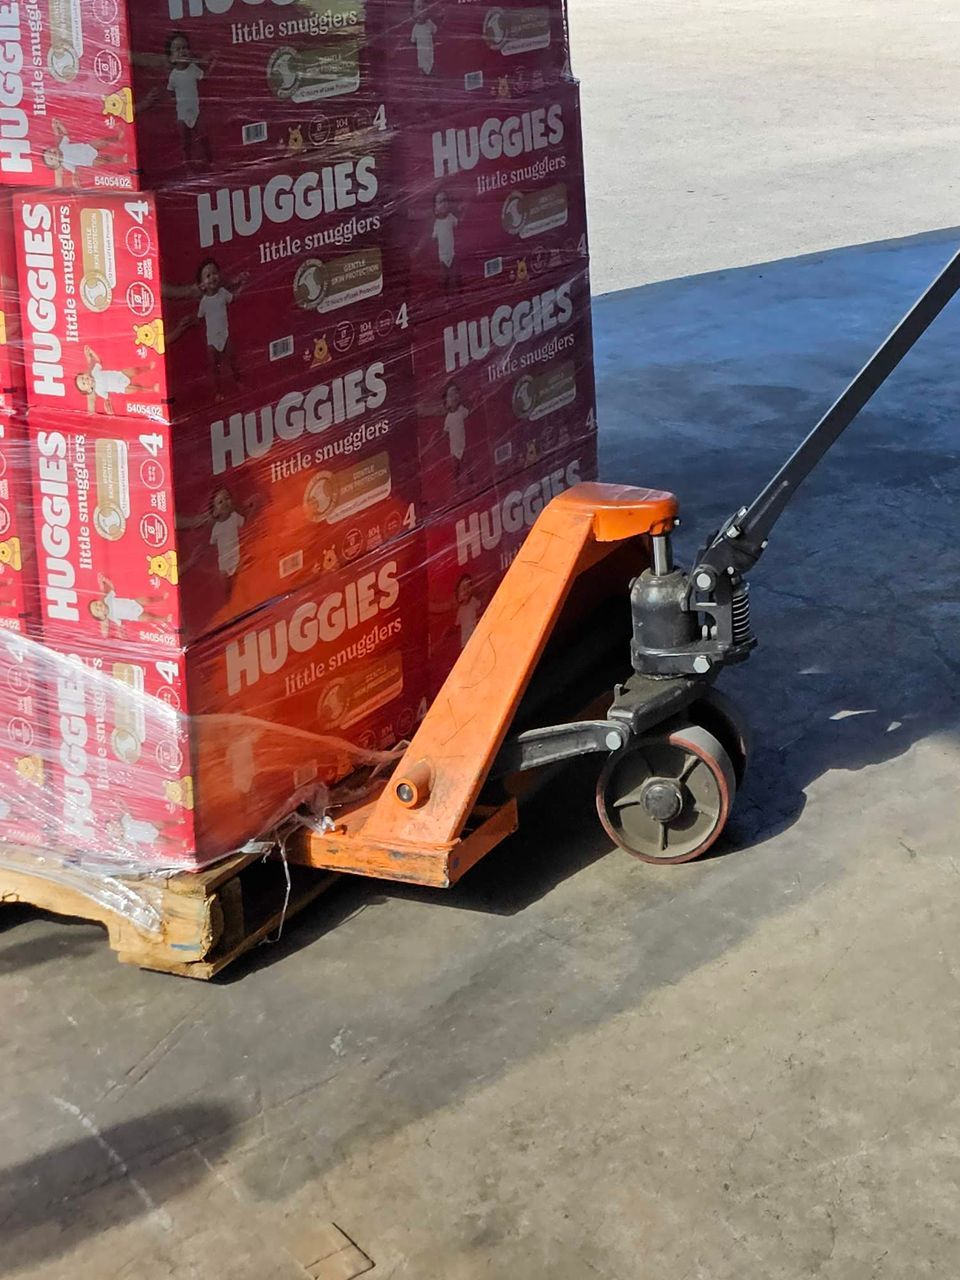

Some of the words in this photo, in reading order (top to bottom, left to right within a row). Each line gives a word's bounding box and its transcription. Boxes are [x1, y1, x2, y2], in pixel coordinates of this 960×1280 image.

[231, 19, 273, 44] little
[279, 9, 357, 36] snugglers
[32, 70, 47, 116] little
[373, 103, 387, 131] 4
[432, 104, 564, 179] HUGGIES
[476, 170, 508, 195] little
[510, 155, 567, 181] snugglers
[125, 200, 151, 224] 4
[198, 156, 378, 248] HUGGIES
[60, 204, 75, 295] snugglers
[91, 212, 99, 252] PROTECTION
[259, 236, 301, 264] little
[304, 216, 381, 245] snugglers
[22, 203, 66, 397] HUGGIES
[66, 298, 79, 343] little
[395, 302, 409, 329] 4
[443, 283, 573, 373] HUGGIES
[520, 332, 575, 368] snugglers
[210, 361, 388, 475] HUGGIES
[585, 407, 597, 431] 4
[140, 432, 163, 457] 4
[271, 452, 312, 483] little
[315, 419, 390, 456] snugglers
[74, 433, 90, 523] snugglers
[37, 431, 79, 622] HUGGIES
[403, 502, 416, 530] 4
[80, 525, 93, 570] little
[226, 560, 400, 696] HUGGIES
[155, 661, 179, 685] 4
[284, 662, 325, 696] little
[328, 618, 402, 671] snugglers
